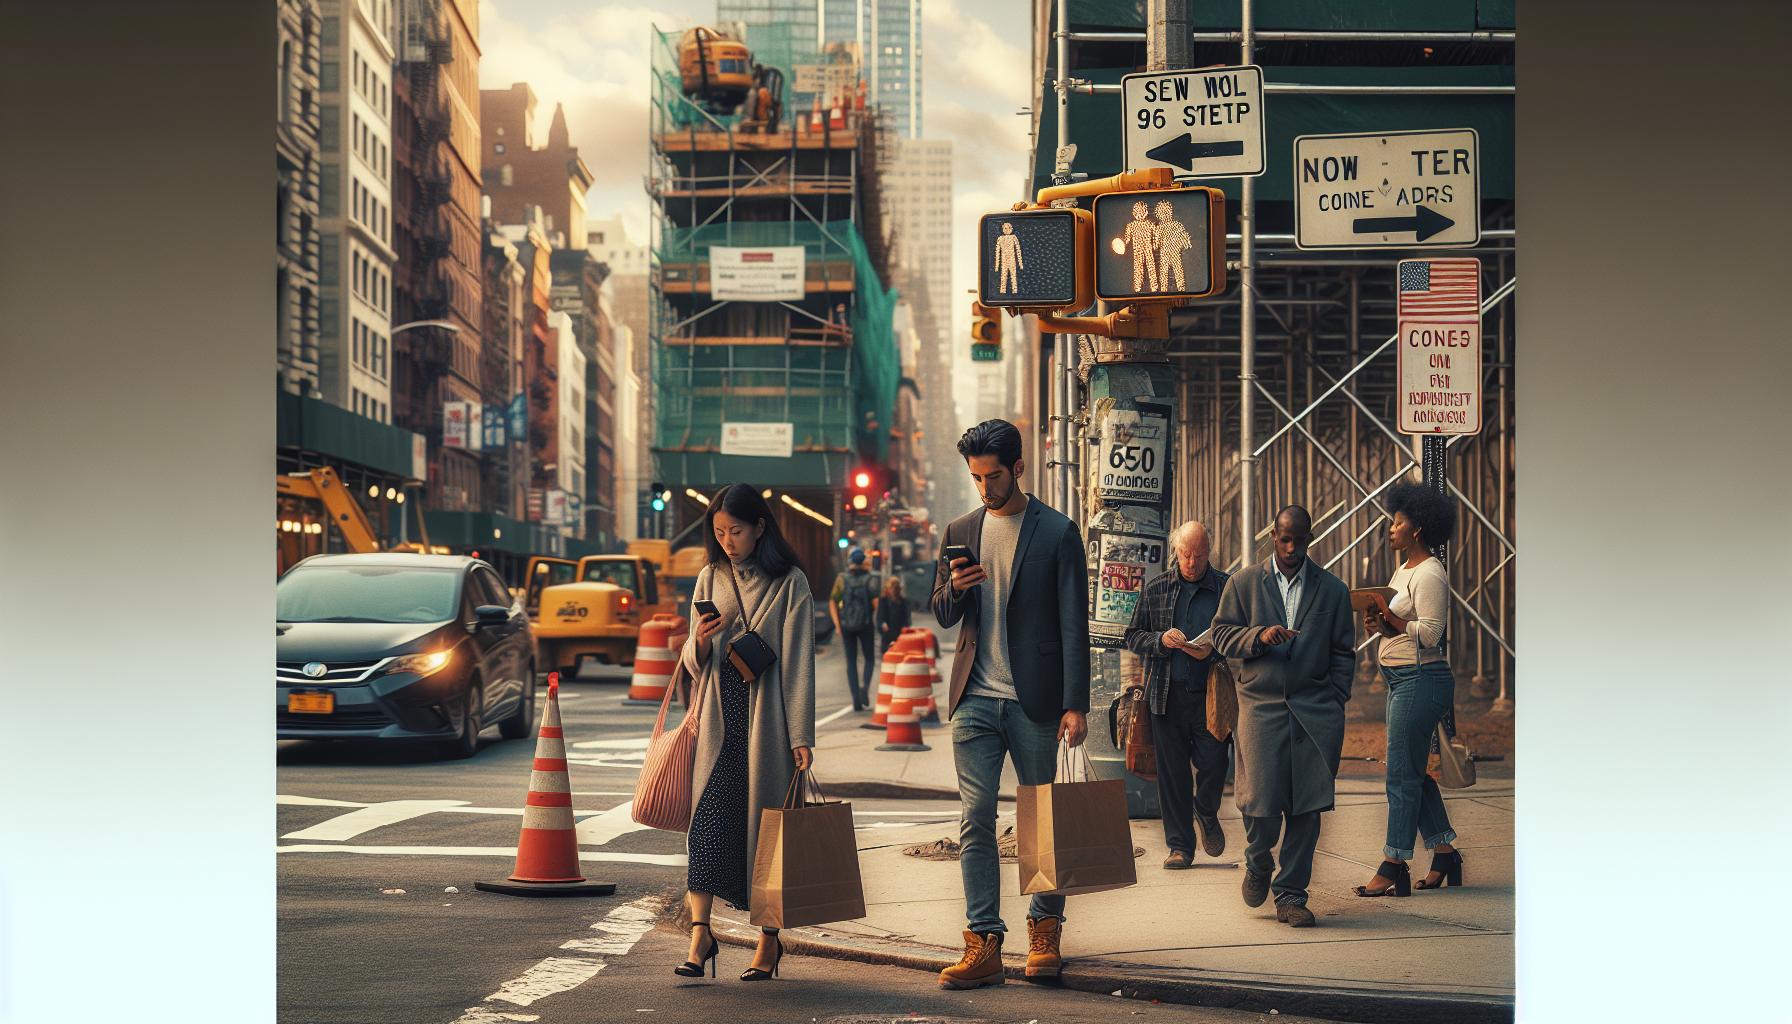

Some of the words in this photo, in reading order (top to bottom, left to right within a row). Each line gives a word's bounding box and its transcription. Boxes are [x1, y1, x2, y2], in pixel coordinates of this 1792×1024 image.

[1144, 76, 1189, 103] SEW
[1137, 108, 1167, 130] 96
[1303, 155, 1358, 183] NOW
[1411, 149, 1471, 177] TER
[1109, 443, 1155, 474] 650
